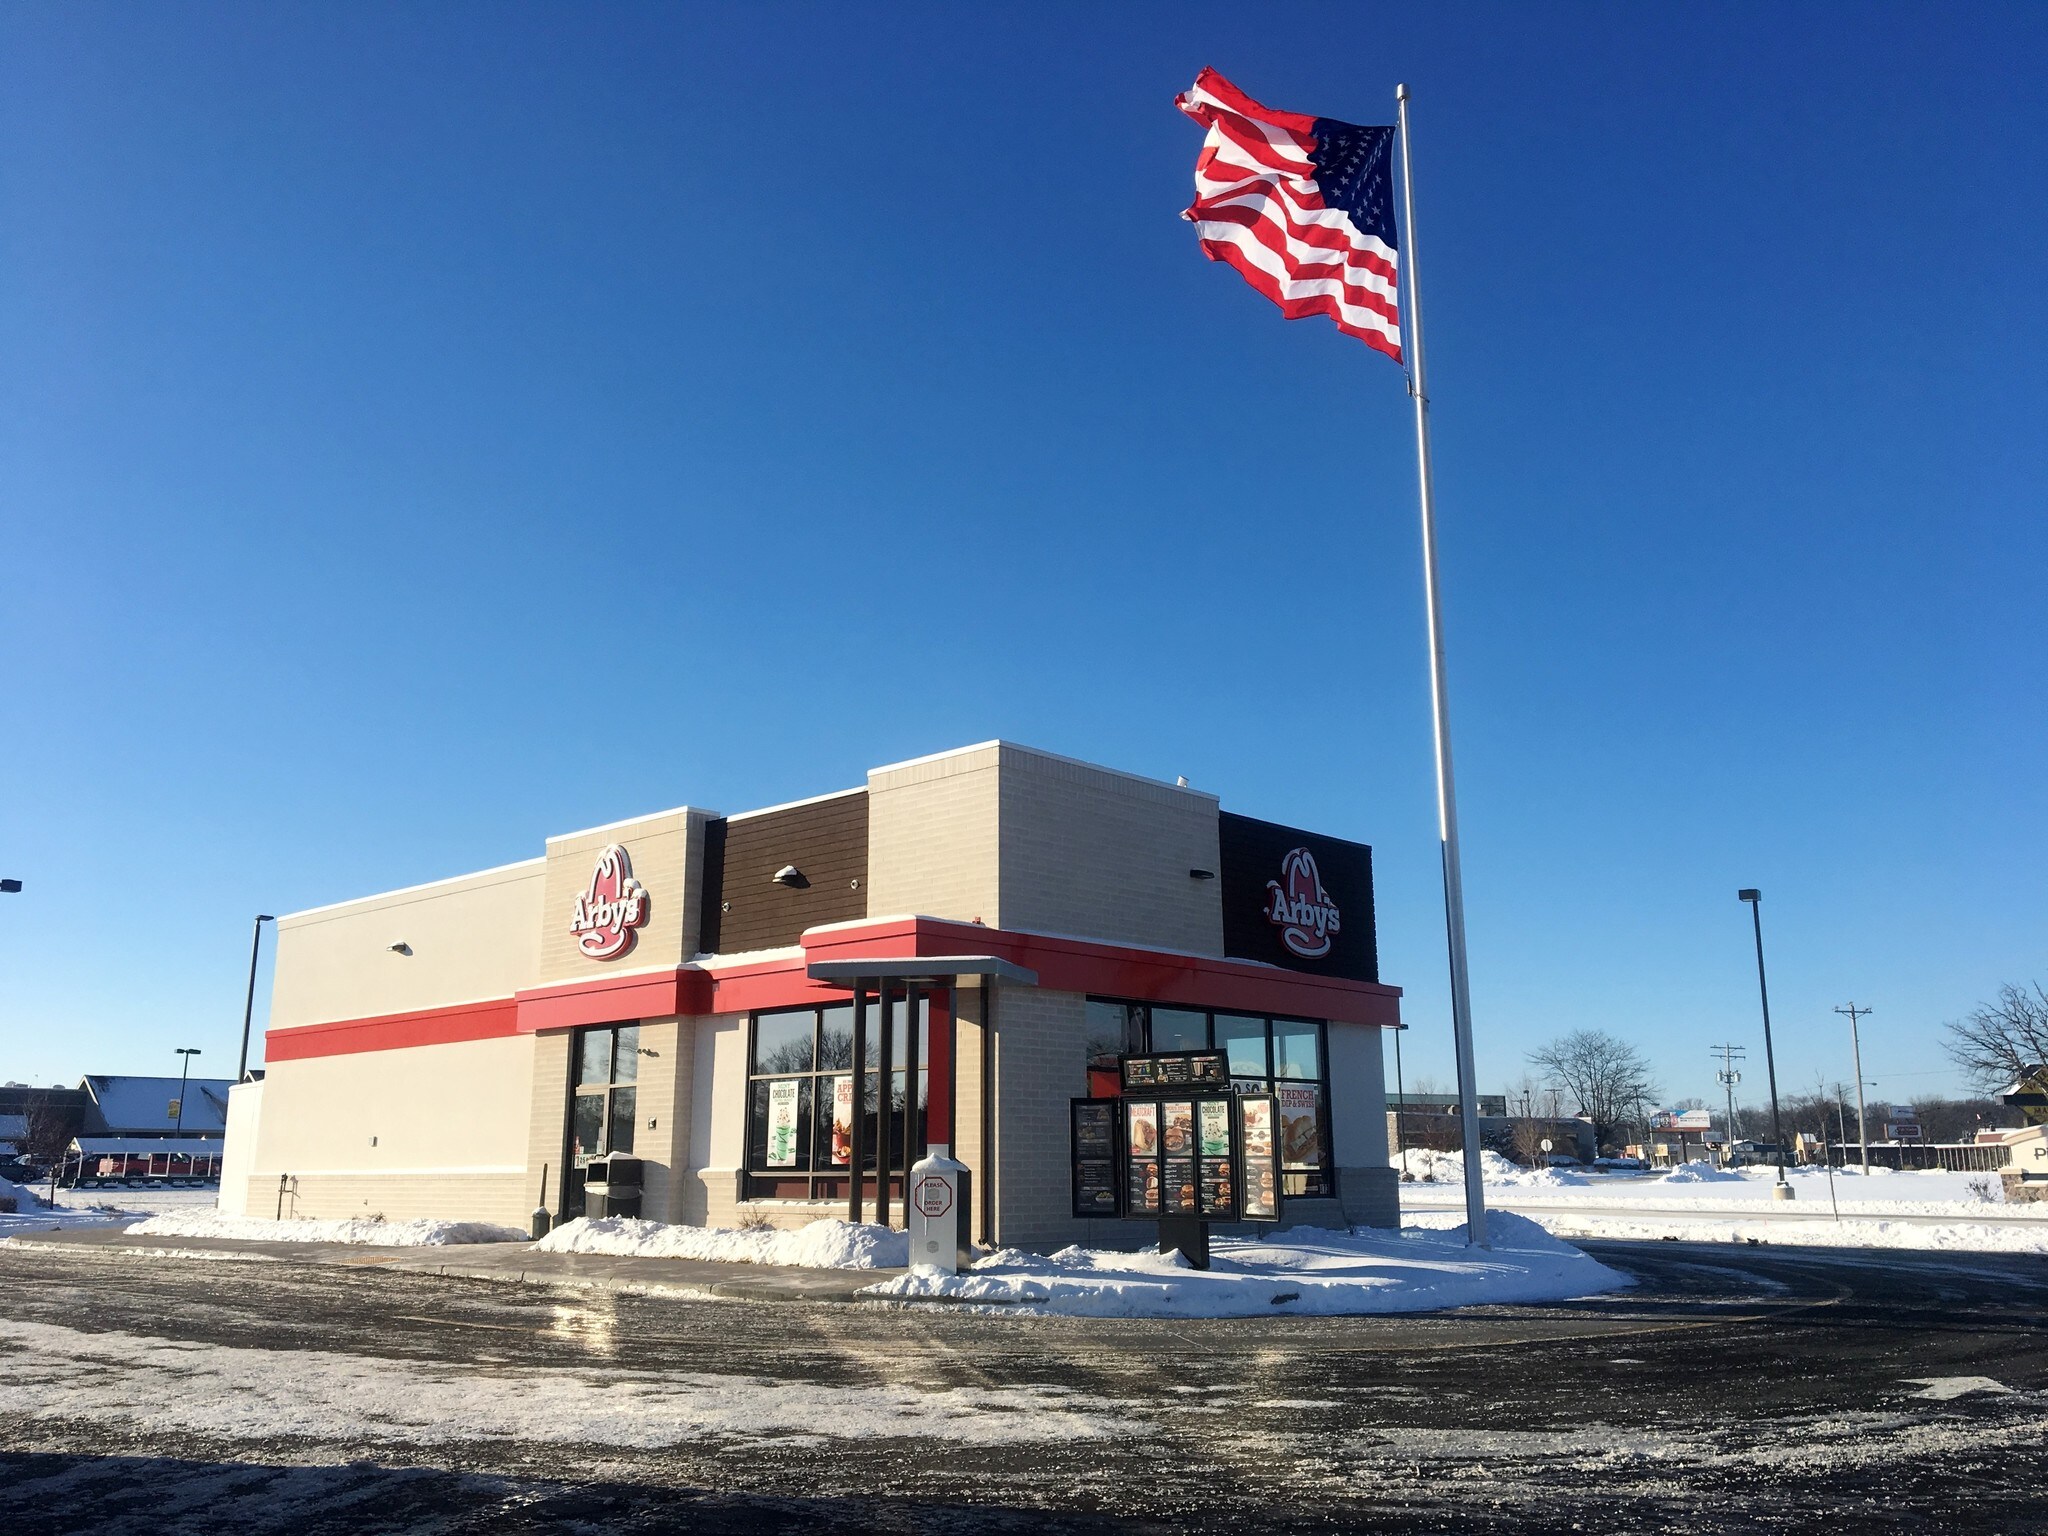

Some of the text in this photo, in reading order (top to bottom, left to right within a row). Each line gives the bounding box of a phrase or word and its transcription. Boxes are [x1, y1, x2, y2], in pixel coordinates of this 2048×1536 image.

[570, 887, 640, 934] Arby's
[1272, 888, 1340, 938] Arby's
[773, 1089, 795, 1098] CHOCOLATE
[837, 1084, 853, 1093] APP
[1281, 1089, 1314, 1100] FRENCH
[1202, 1105, 1224, 1114] CHOCOLATE
[2034, 1147, 2048, 1160] P
